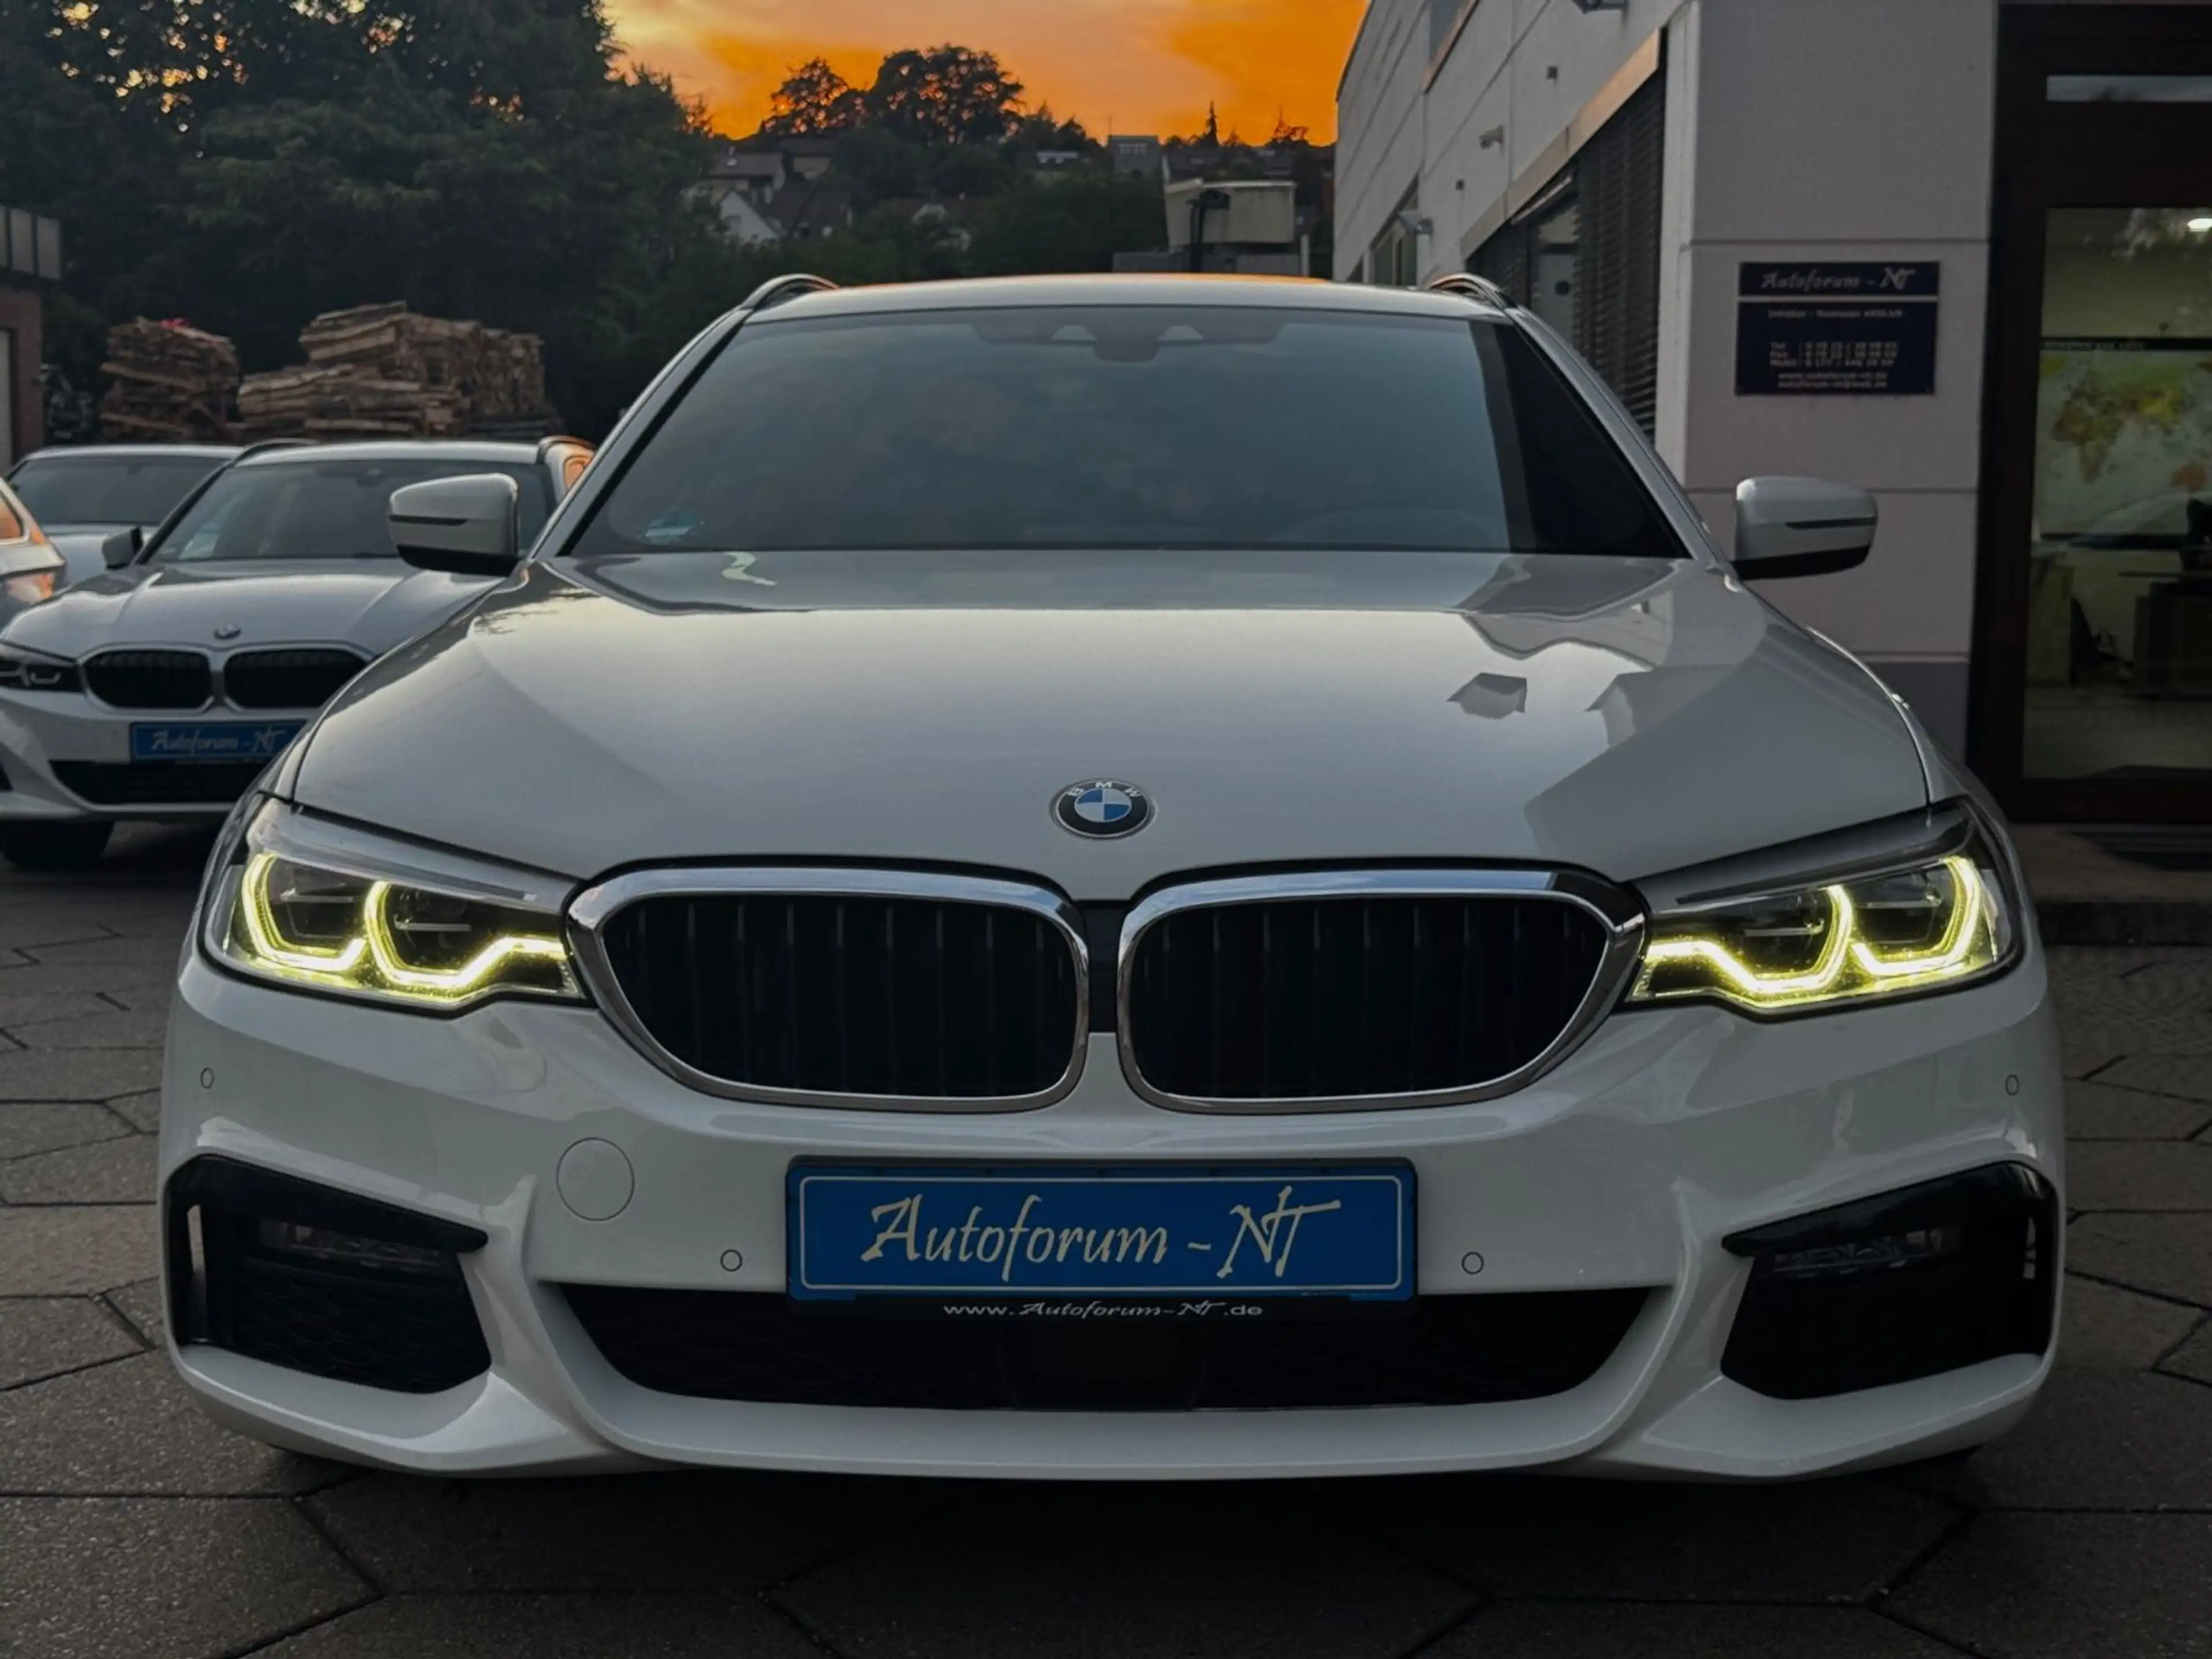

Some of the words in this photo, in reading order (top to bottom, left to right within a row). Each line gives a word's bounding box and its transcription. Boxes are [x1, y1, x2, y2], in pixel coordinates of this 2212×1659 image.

[1760, 268, 1860, 291] Autoforum
[152, 729, 238, 757] Autoforum
[1066, 781, 1141, 797] BMW
[861, 1194, 1168, 1283] Autoforum
[943, 1300, 1263, 1319] www.Autoforum-NT.de
